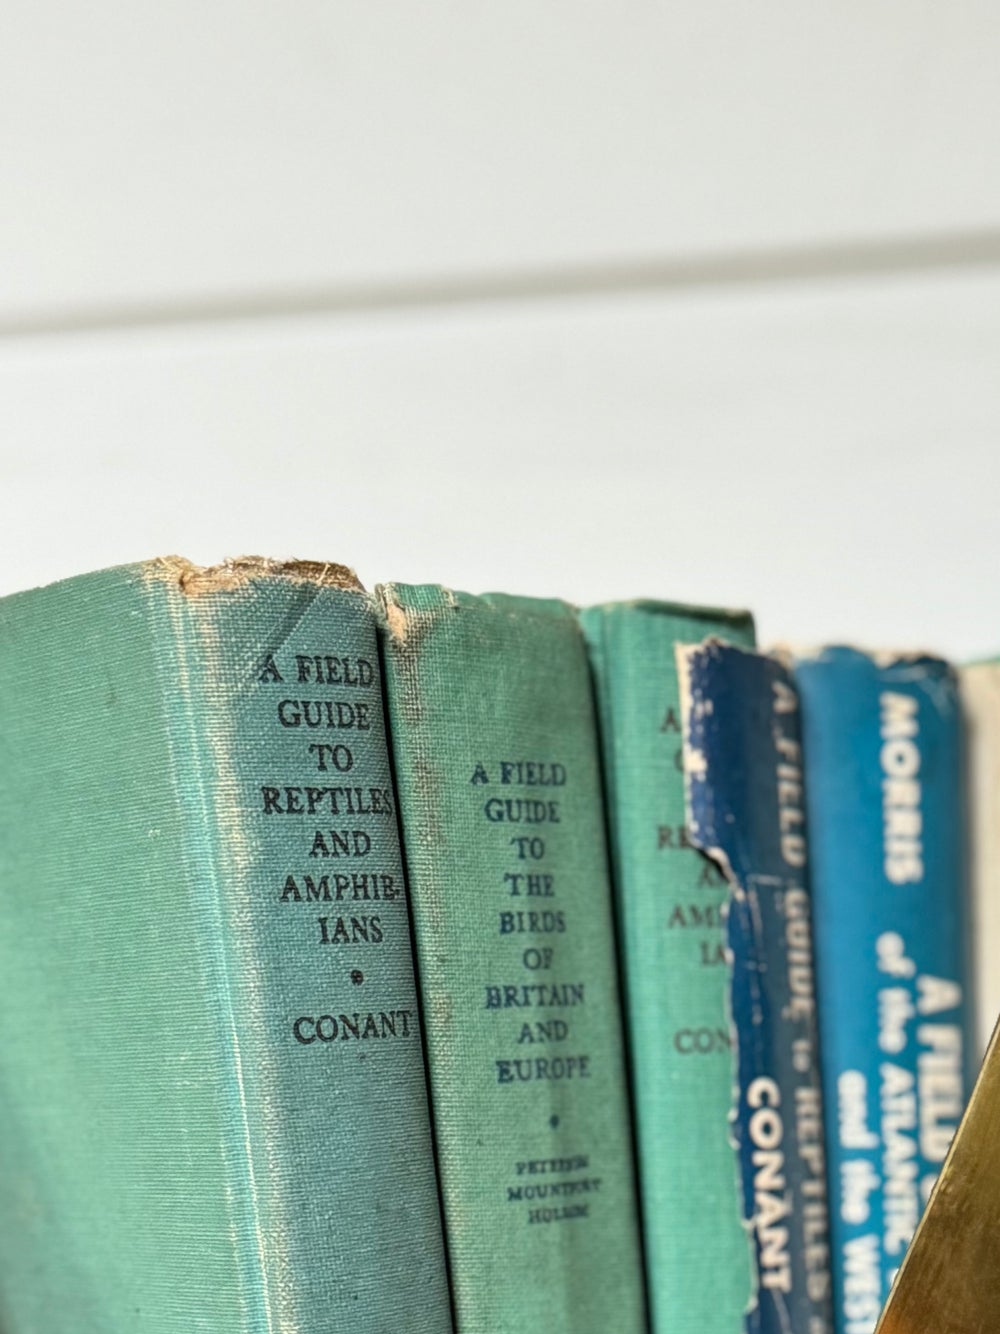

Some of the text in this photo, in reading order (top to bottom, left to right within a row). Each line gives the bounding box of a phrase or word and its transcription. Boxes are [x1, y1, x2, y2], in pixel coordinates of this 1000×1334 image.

[258, 653, 375, 688] A FIELD
[771, 680, 798, 714] A
[278, 700, 370, 730] GUIDE
[660, 707, 682, 733] A
[309, 743, 354, 772] TO
[471, 761, 567, 786] A FIELD
[878, 690, 925, 885] MORRIS
[261, 786, 394, 815] REPTILES
[484, 798, 561, 823] GUIDE
[774, 734, 808, 868] FIELD
[309, 831, 371, 857] AND
[510, 837, 545, 860] TO
[504, 873, 555, 896] THE
[318, 916, 384, 944] IANS
[500, 911, 566, 934] BIRDS
[522, 948, 554, 970] OF
[783, 888, 816, 1020] GUIDE
[485, 983, 584, 1010] BRITAIN
[916, 973, 961, 1017] A
[293, 1010, 413, 1044] CONANT
[518, 1019, 568, 1044] AND
[496, 1055, 591, 1084] EUROPE
[876, 931, 920, 1255] of the ATLANTIC
[916, 1024, 963, 1163] FIELD
[837, 1069, 880, 1150] and
[747, 1075, 792, 1294] CONANT
[795, 1087, 831, 1301] REPTILES
[840, 1159, 881, 1225] the
